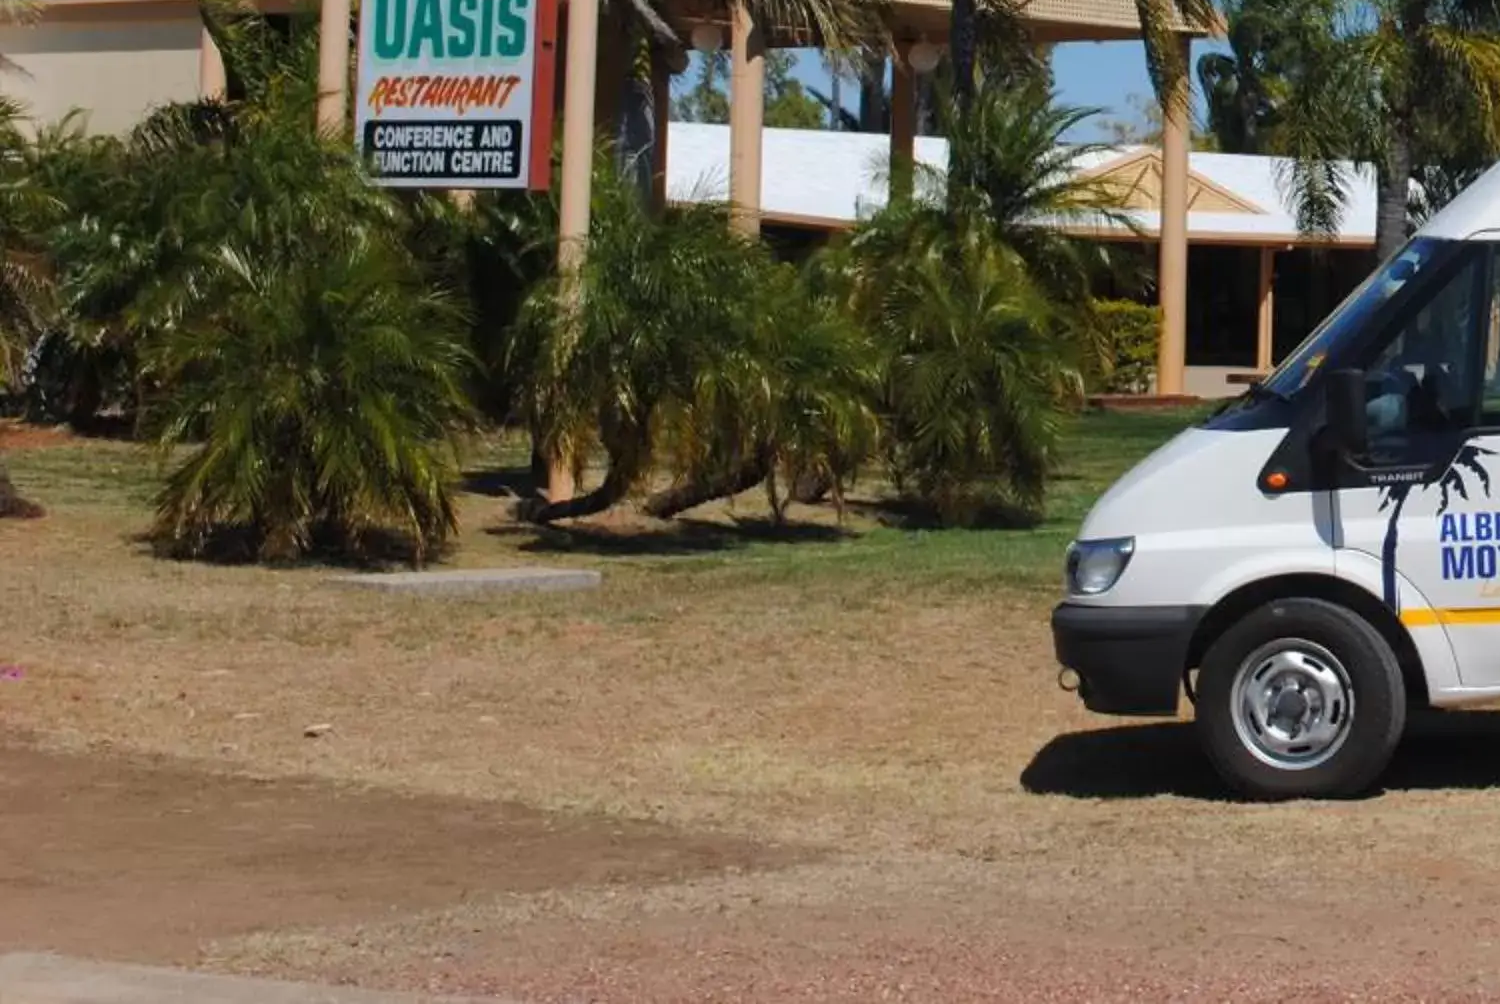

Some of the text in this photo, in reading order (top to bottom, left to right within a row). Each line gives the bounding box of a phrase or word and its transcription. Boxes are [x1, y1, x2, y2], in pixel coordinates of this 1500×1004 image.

[369, 76, 521, 115] RESTAURANT
[374, 125, 512, 148] CONFERENCE AND
[451, 150, 513, 173] CENTRE
